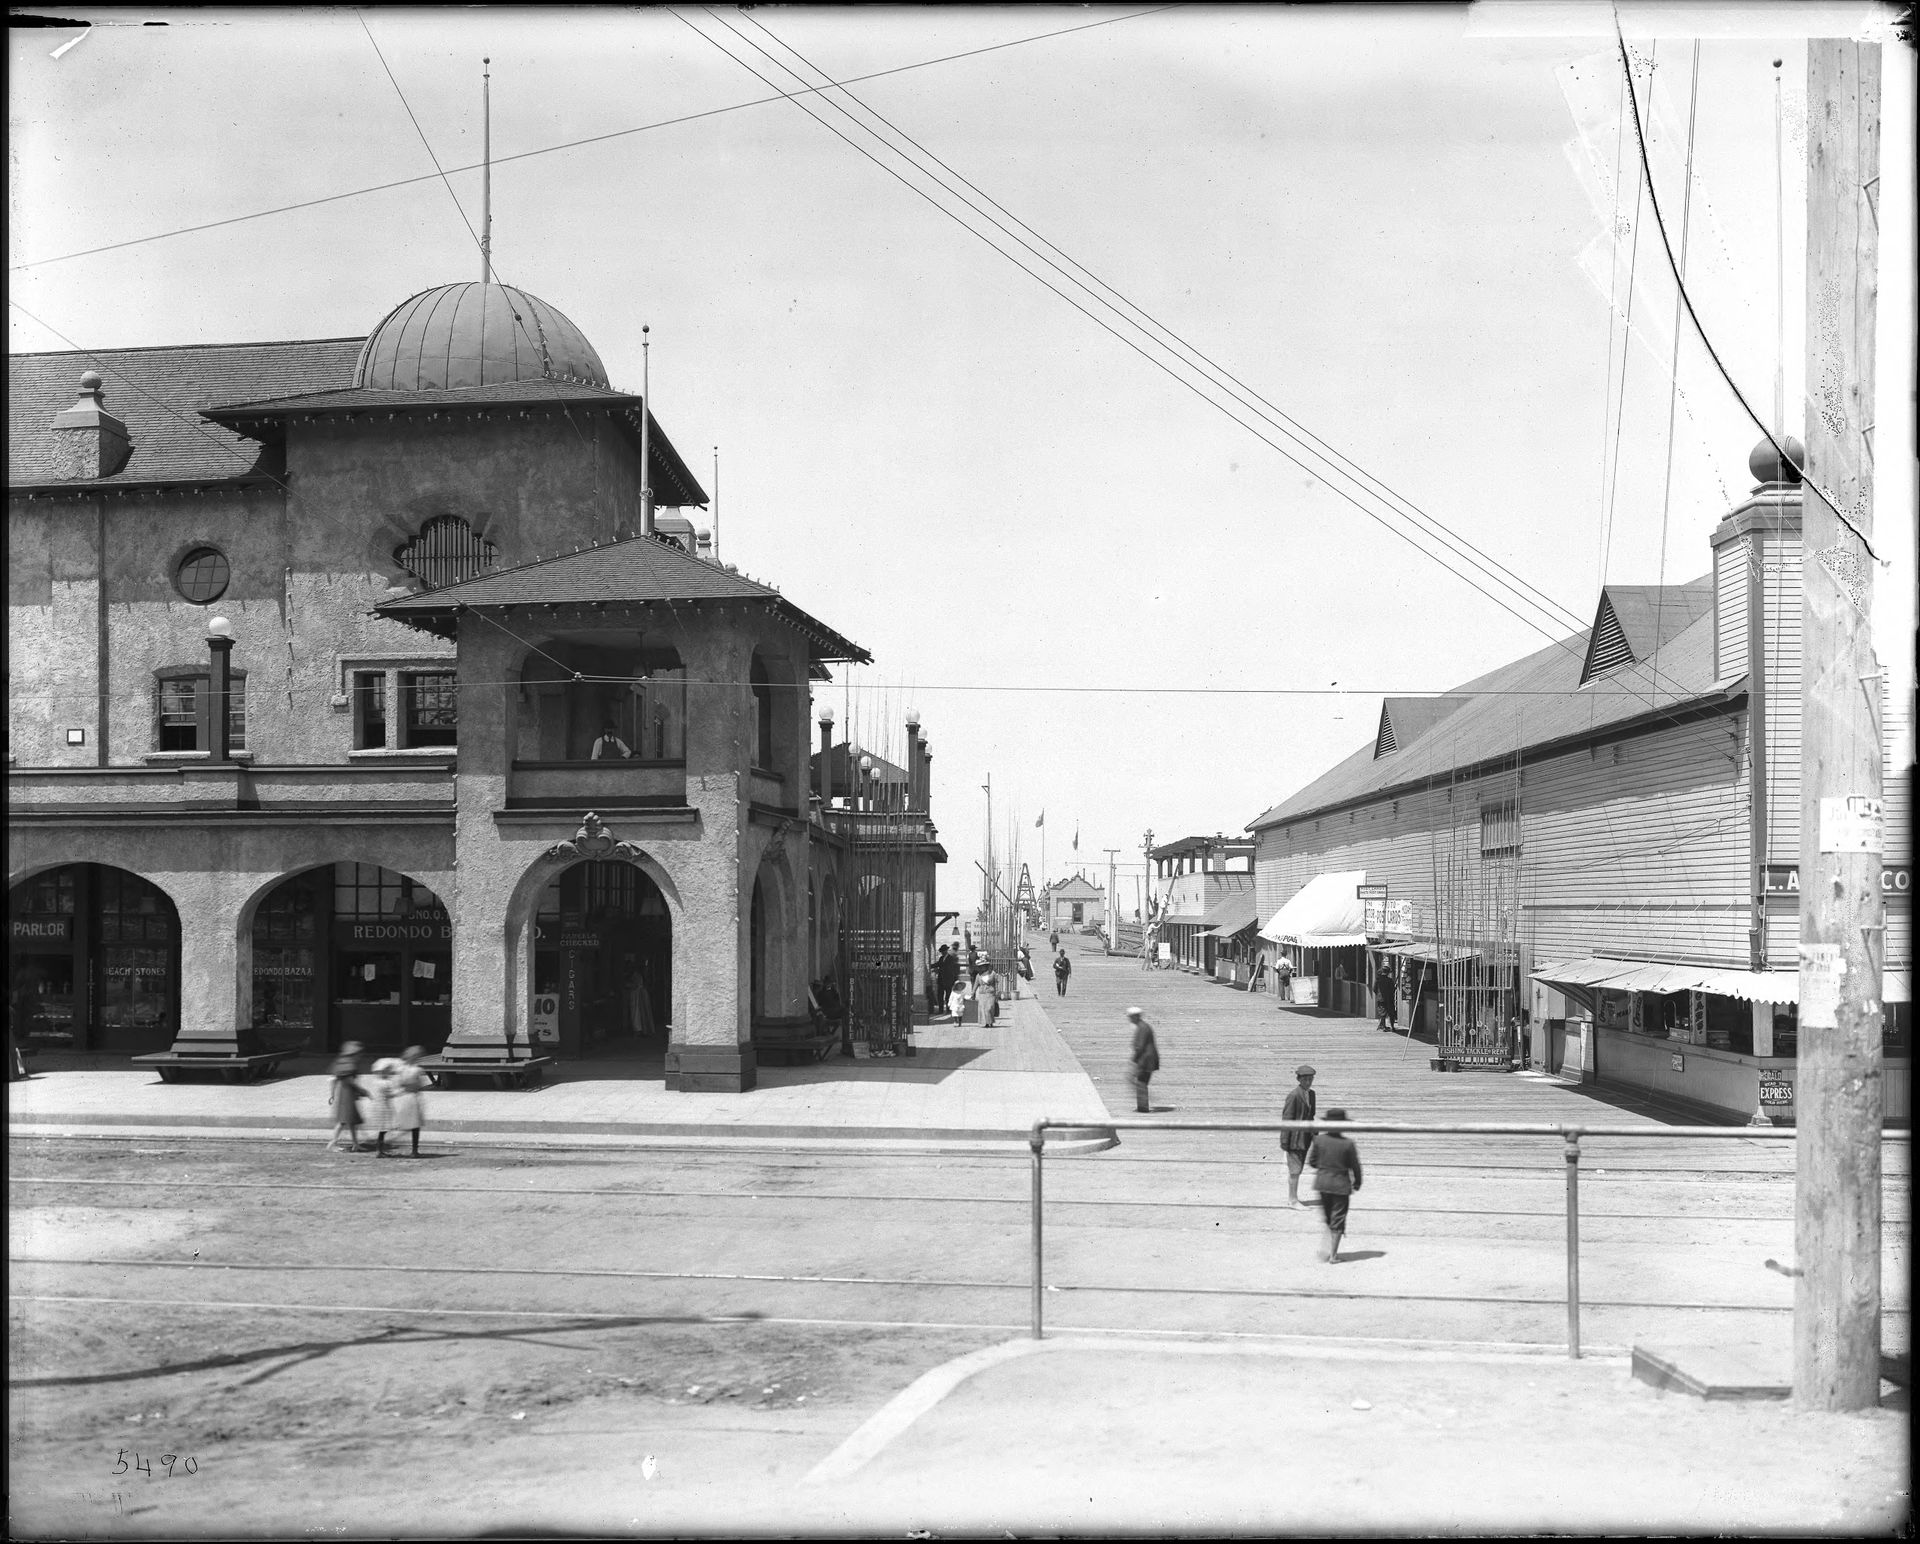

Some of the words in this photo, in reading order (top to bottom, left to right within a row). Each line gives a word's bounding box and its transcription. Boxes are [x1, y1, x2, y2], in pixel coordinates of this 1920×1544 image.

[13, 922, 65, 936] PARLOR
[353, 926, 433, 938] REDONDO
[135, 968, 166, 976] STONES
[568, 950, 576, 1011] CIGARS
[1760, 1087, 1793, 1099] EXPRESS
